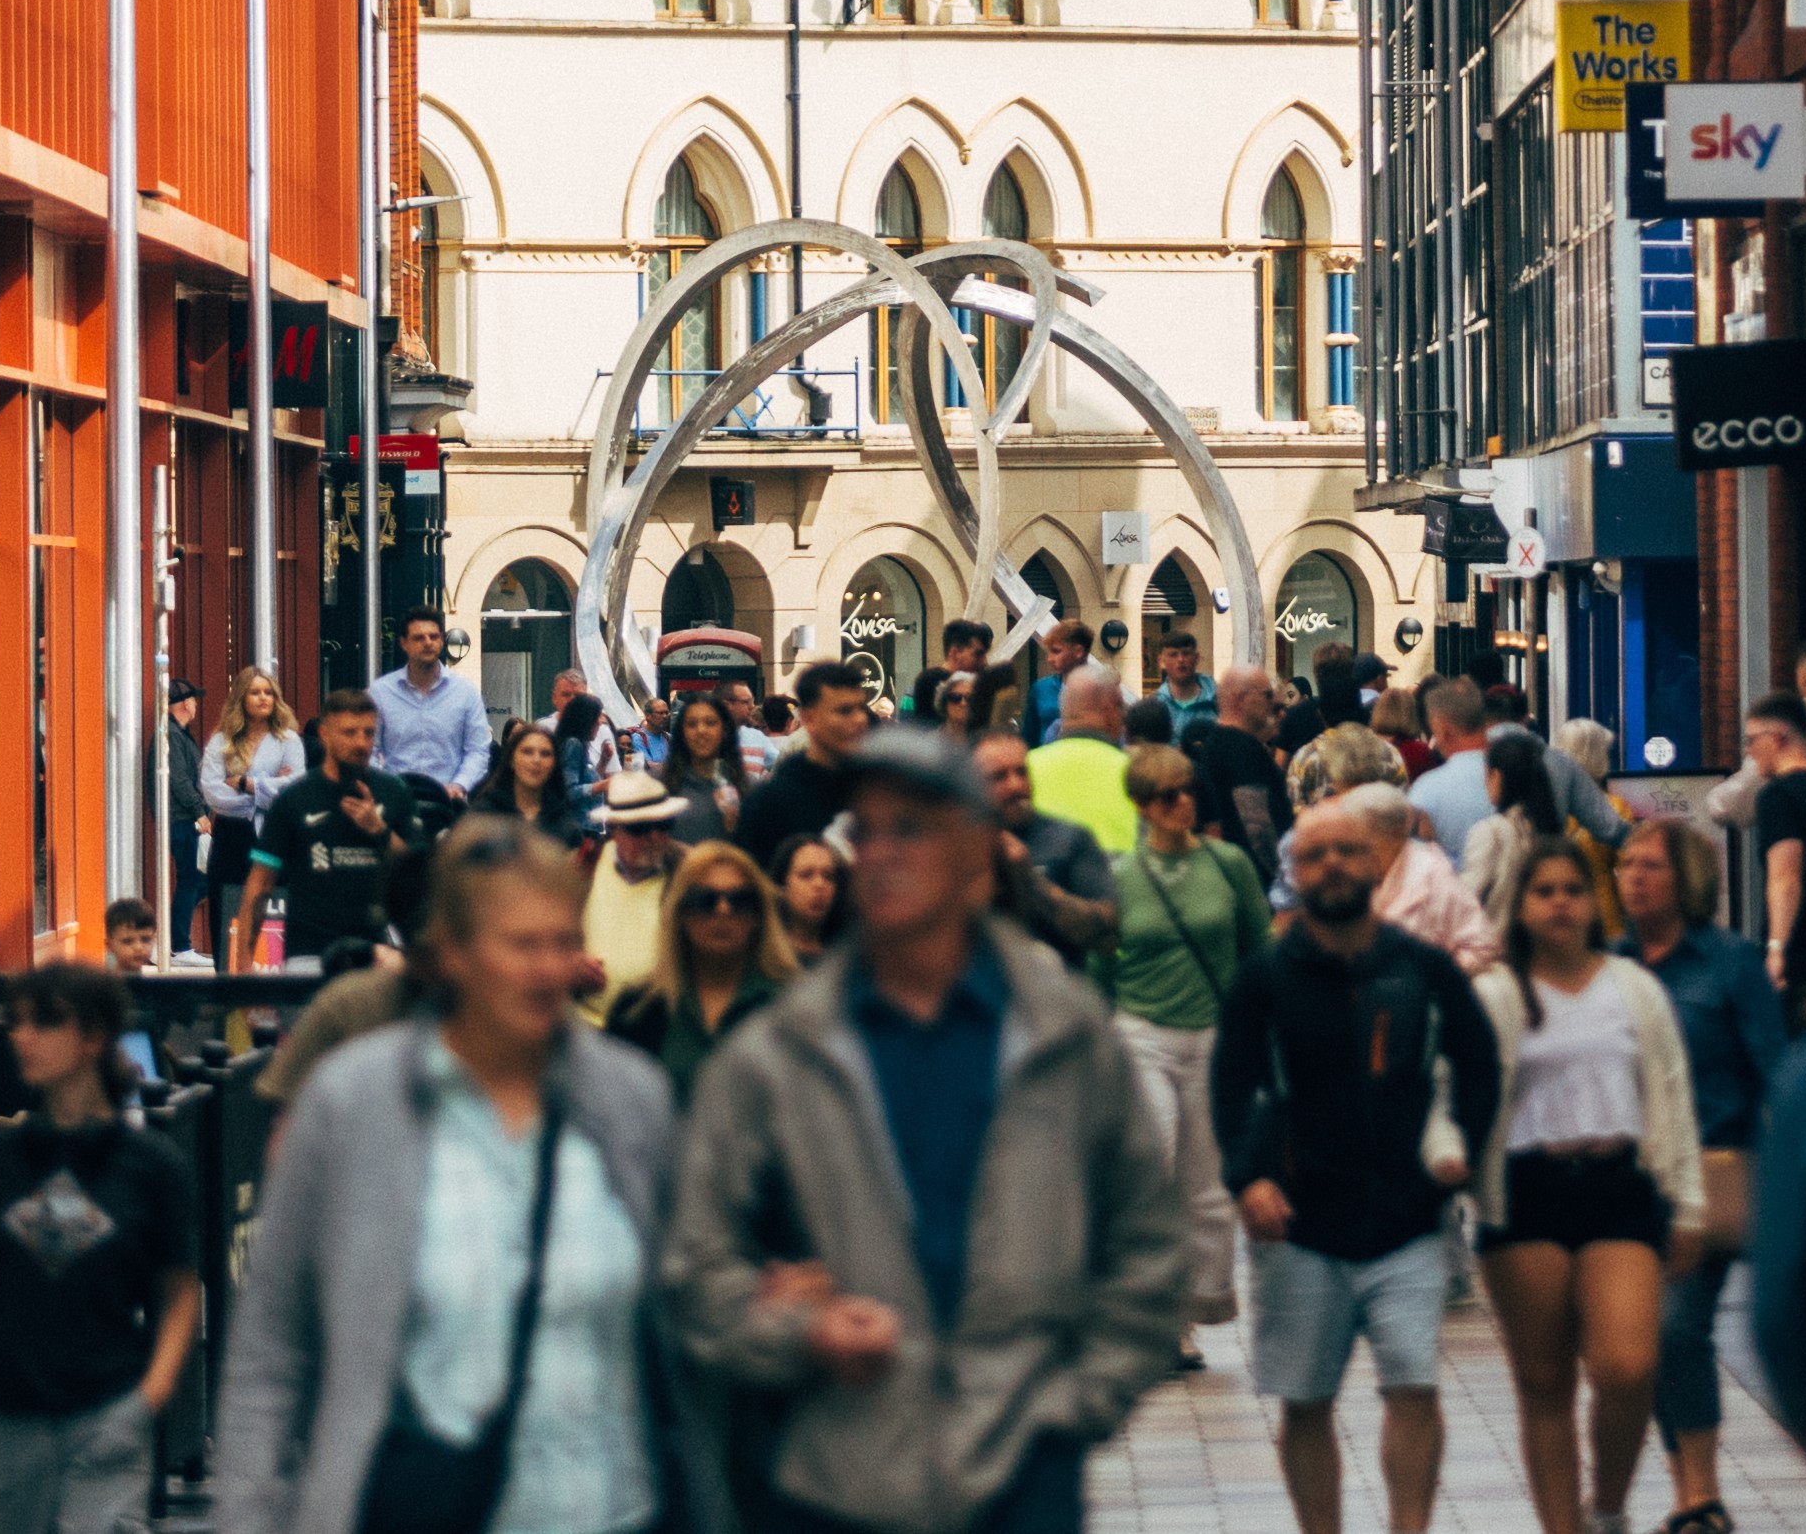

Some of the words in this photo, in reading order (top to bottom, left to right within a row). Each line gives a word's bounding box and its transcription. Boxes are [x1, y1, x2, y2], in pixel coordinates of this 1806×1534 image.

[1592, 15, 1656, 46] The
[1571, 49, 1678, 82] Works
[1689, 112, 1783, 170] sky
[1691, 413, 1805, 451] ecco
[840, 592, 905, 648] Lovisa
[1274, 594, 1337, 642] Lovisa
[686, 649, 732, 662] Telephone
